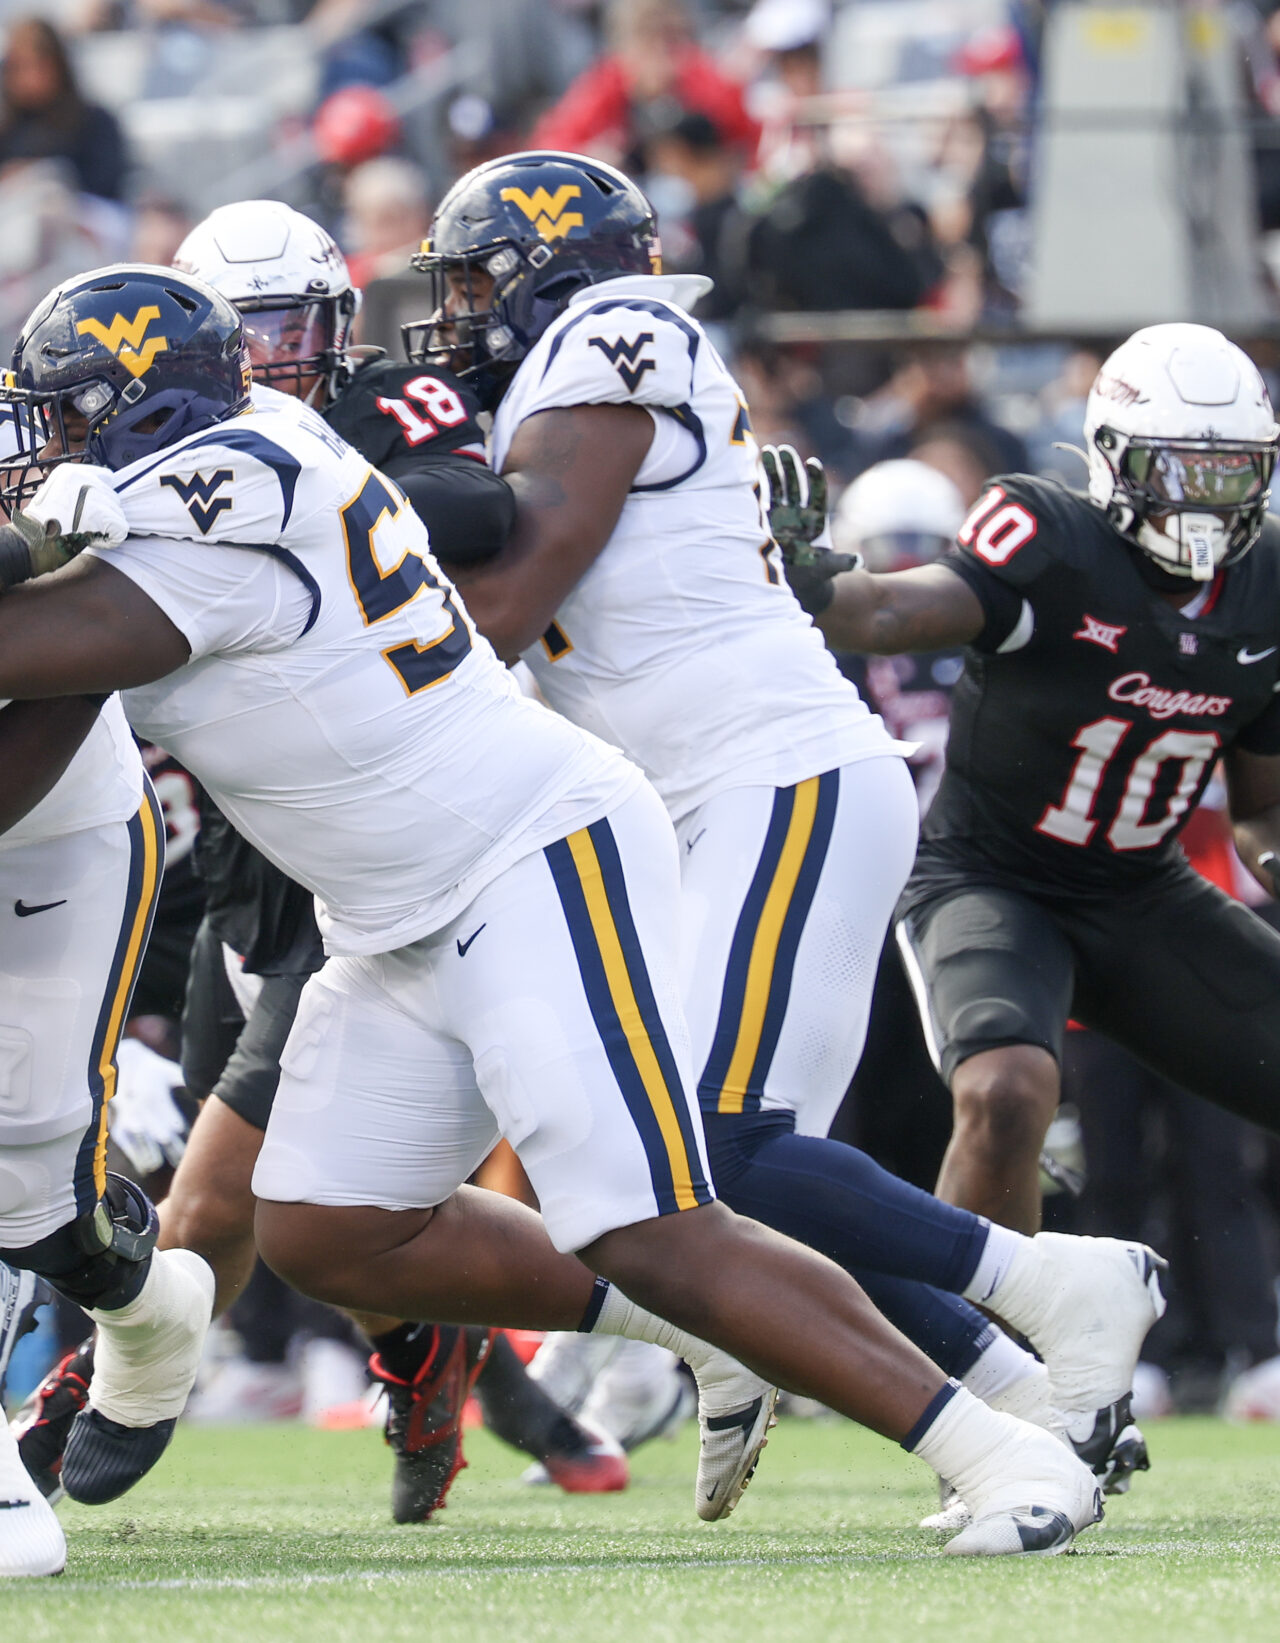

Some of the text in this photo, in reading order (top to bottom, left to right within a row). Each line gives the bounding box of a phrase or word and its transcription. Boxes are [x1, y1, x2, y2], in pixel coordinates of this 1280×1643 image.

[376, 374, 469, 448] 18
[958, 485, 1038, 567] 10
[1107, 671, 1233, 720] Cougars
[1032, 714, 1223, 853] 10
